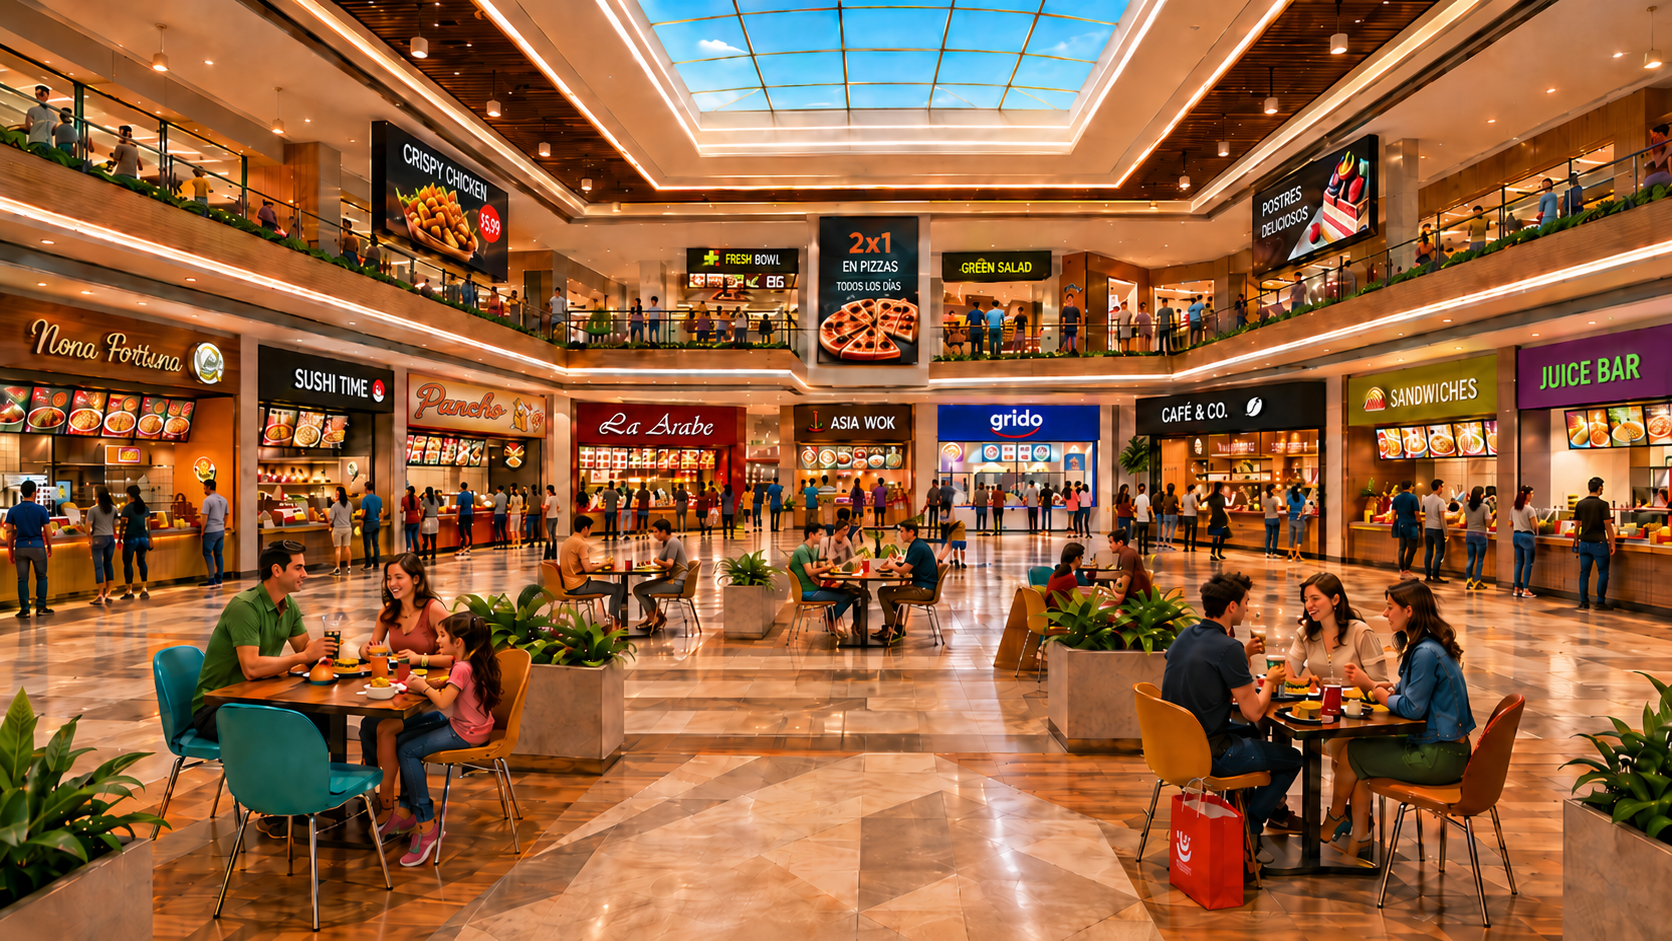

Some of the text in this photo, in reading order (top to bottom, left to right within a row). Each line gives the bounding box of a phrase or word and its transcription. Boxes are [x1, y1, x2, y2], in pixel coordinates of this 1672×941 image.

[403, 143, 487, 202] CRISPY CHICKEN
[1262, 185, 1302, 217] POSTRES
[1262, 206, 1308, 238] DELICIOSOS
[849, 231, 891, 254] 2x1
[725, 253, 781, 266] FRESH BOWL
[842, 260, 899, 273] EN PIZZAS
[961, 261, 1033, 274] GREEN SALAD
[836, 281, 864, 292] TODOS
[865, 281, 881, 292] LOS
[31, 319, 99, 359] Nona
[294, 367, 369, 398] SUSHI TIME
[1539, 353, 1641, 390] JUICE BAR
[414, 382, 507, 420] Pancho
[1390, 378, 1479, 409] SANDWICHES
[599, 412, 714, 437] La Arabe
[830, 416, 896, 430] ASIA WOK
[990, 409, 1043, 432] grido
[1161, 401, 1229, 424] CAFÉ & CO.
